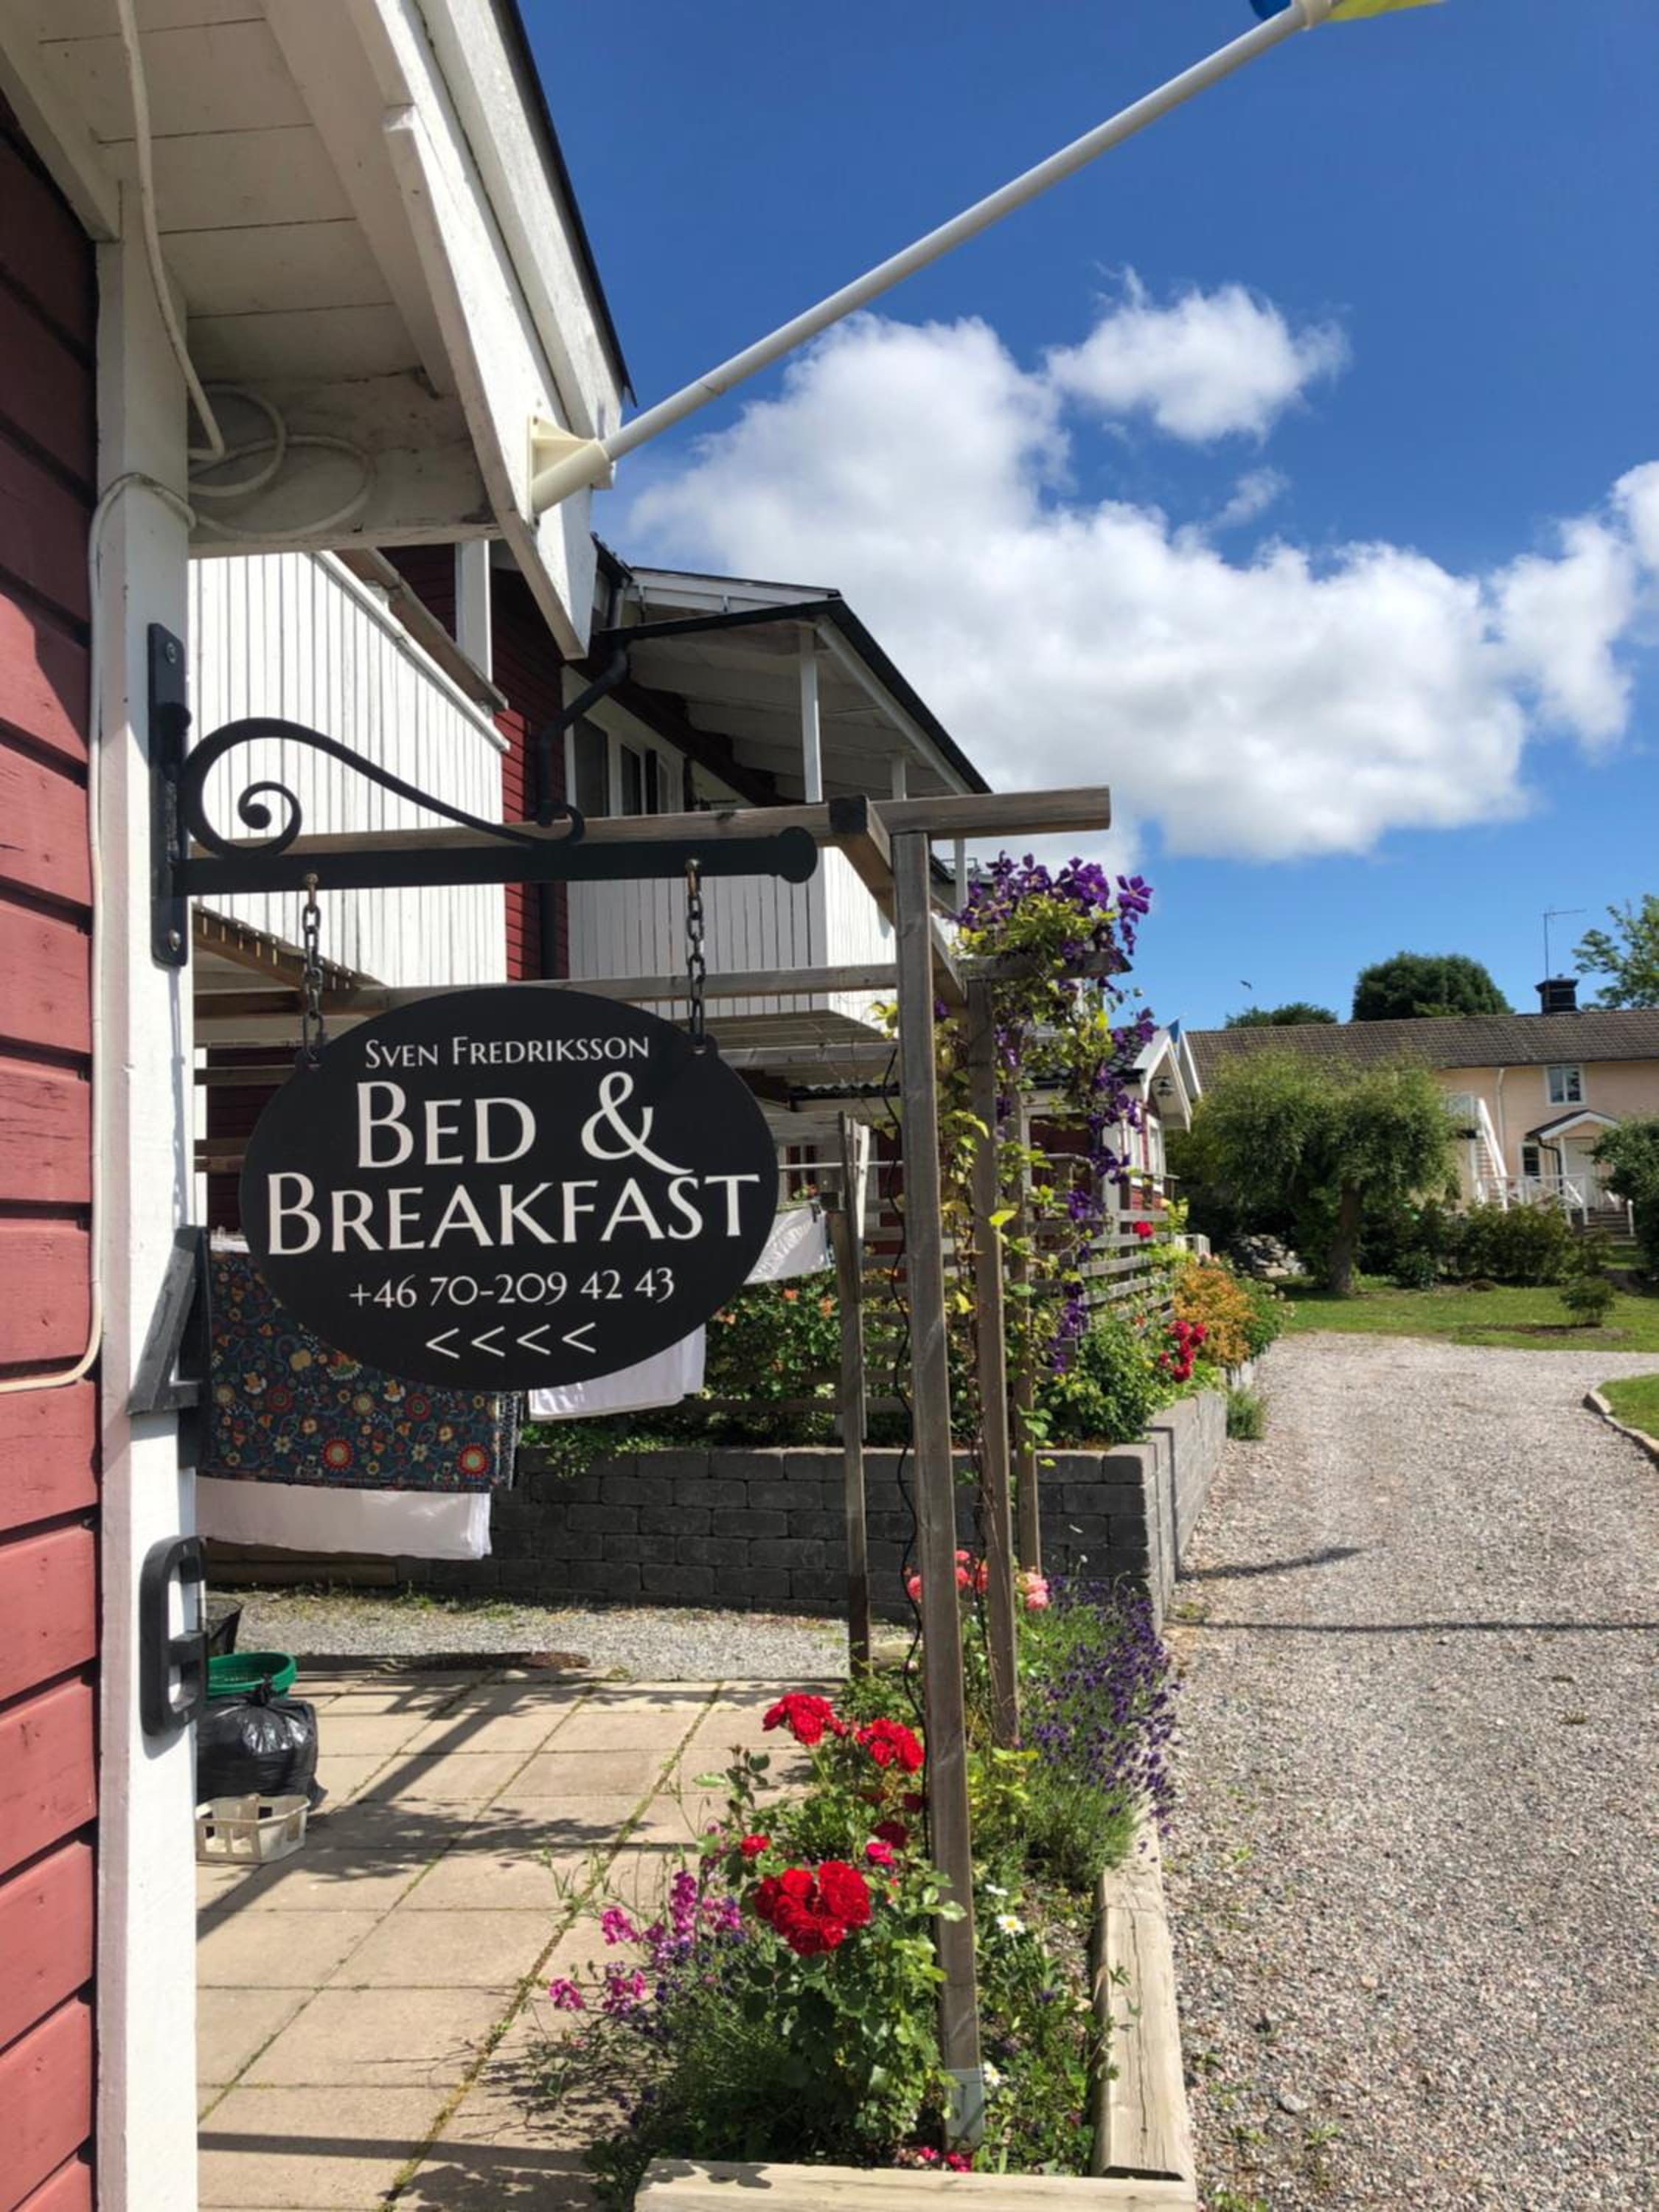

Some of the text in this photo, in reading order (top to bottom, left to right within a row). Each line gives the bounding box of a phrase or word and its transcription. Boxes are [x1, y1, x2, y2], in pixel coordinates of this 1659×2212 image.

[364, 1037, 650, 1068] SVEN FREDRIKSSON
[357, 1071, 694, 1175] BED &
[268, 1172, 760, 1255] BREAKFAST
[349, 1267, 675, 1309] +46 70-209 42 43
